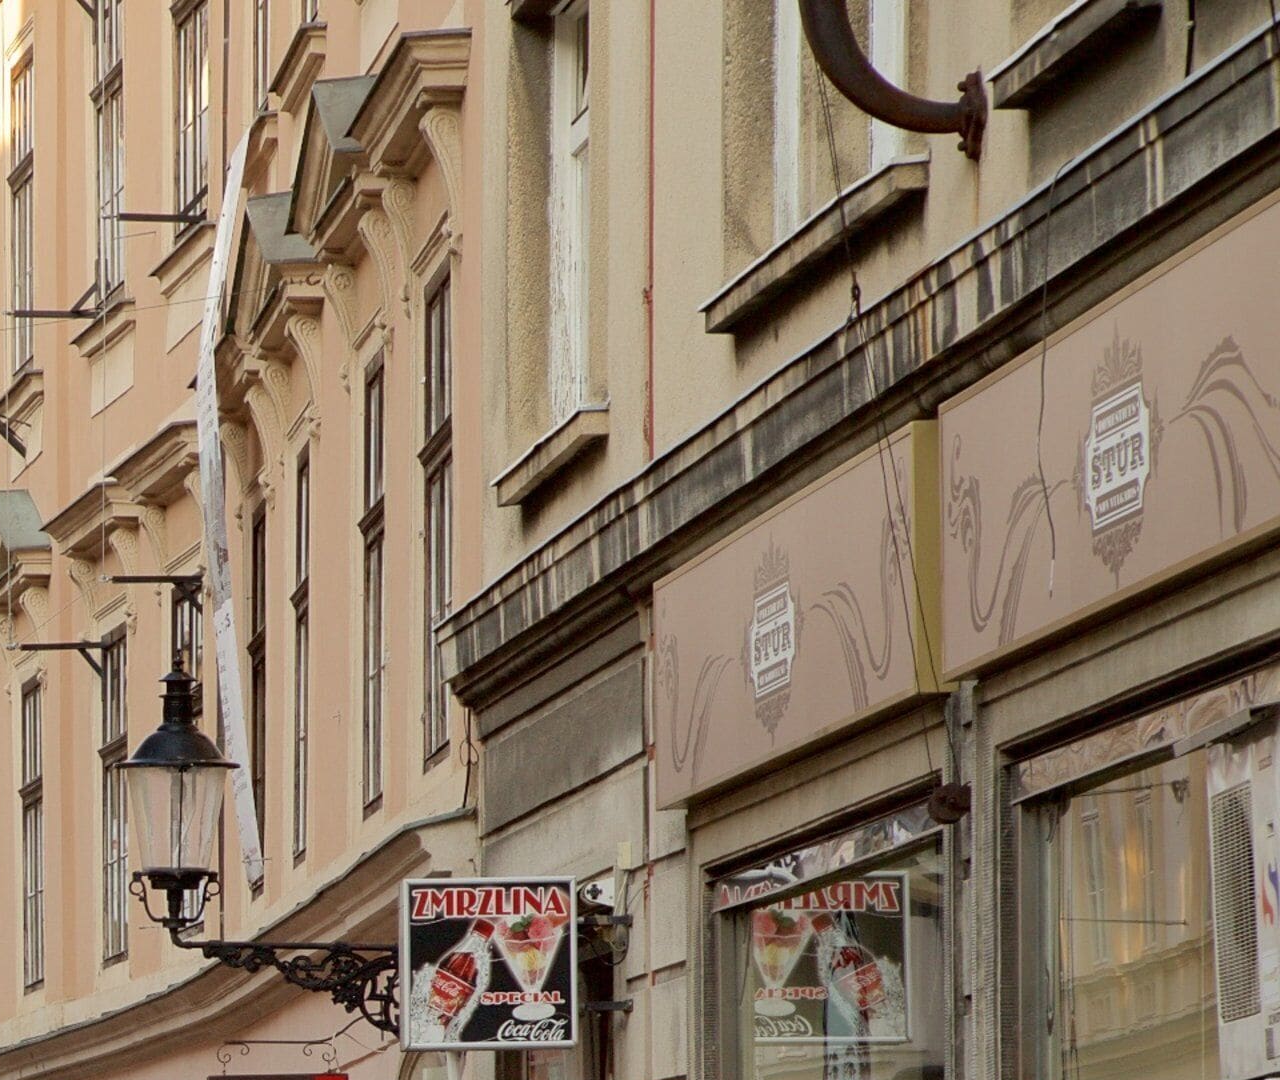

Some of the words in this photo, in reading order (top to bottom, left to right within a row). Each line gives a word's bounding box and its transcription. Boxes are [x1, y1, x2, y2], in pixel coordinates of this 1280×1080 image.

[1091, 432, 1144, 490] ŠTÚR
[412, 886, 569, 920] ZMRZLINA
[480, 990, 566, 1006] SPECIAL
[496, 1014, 569, 1041] Coca-Cola
